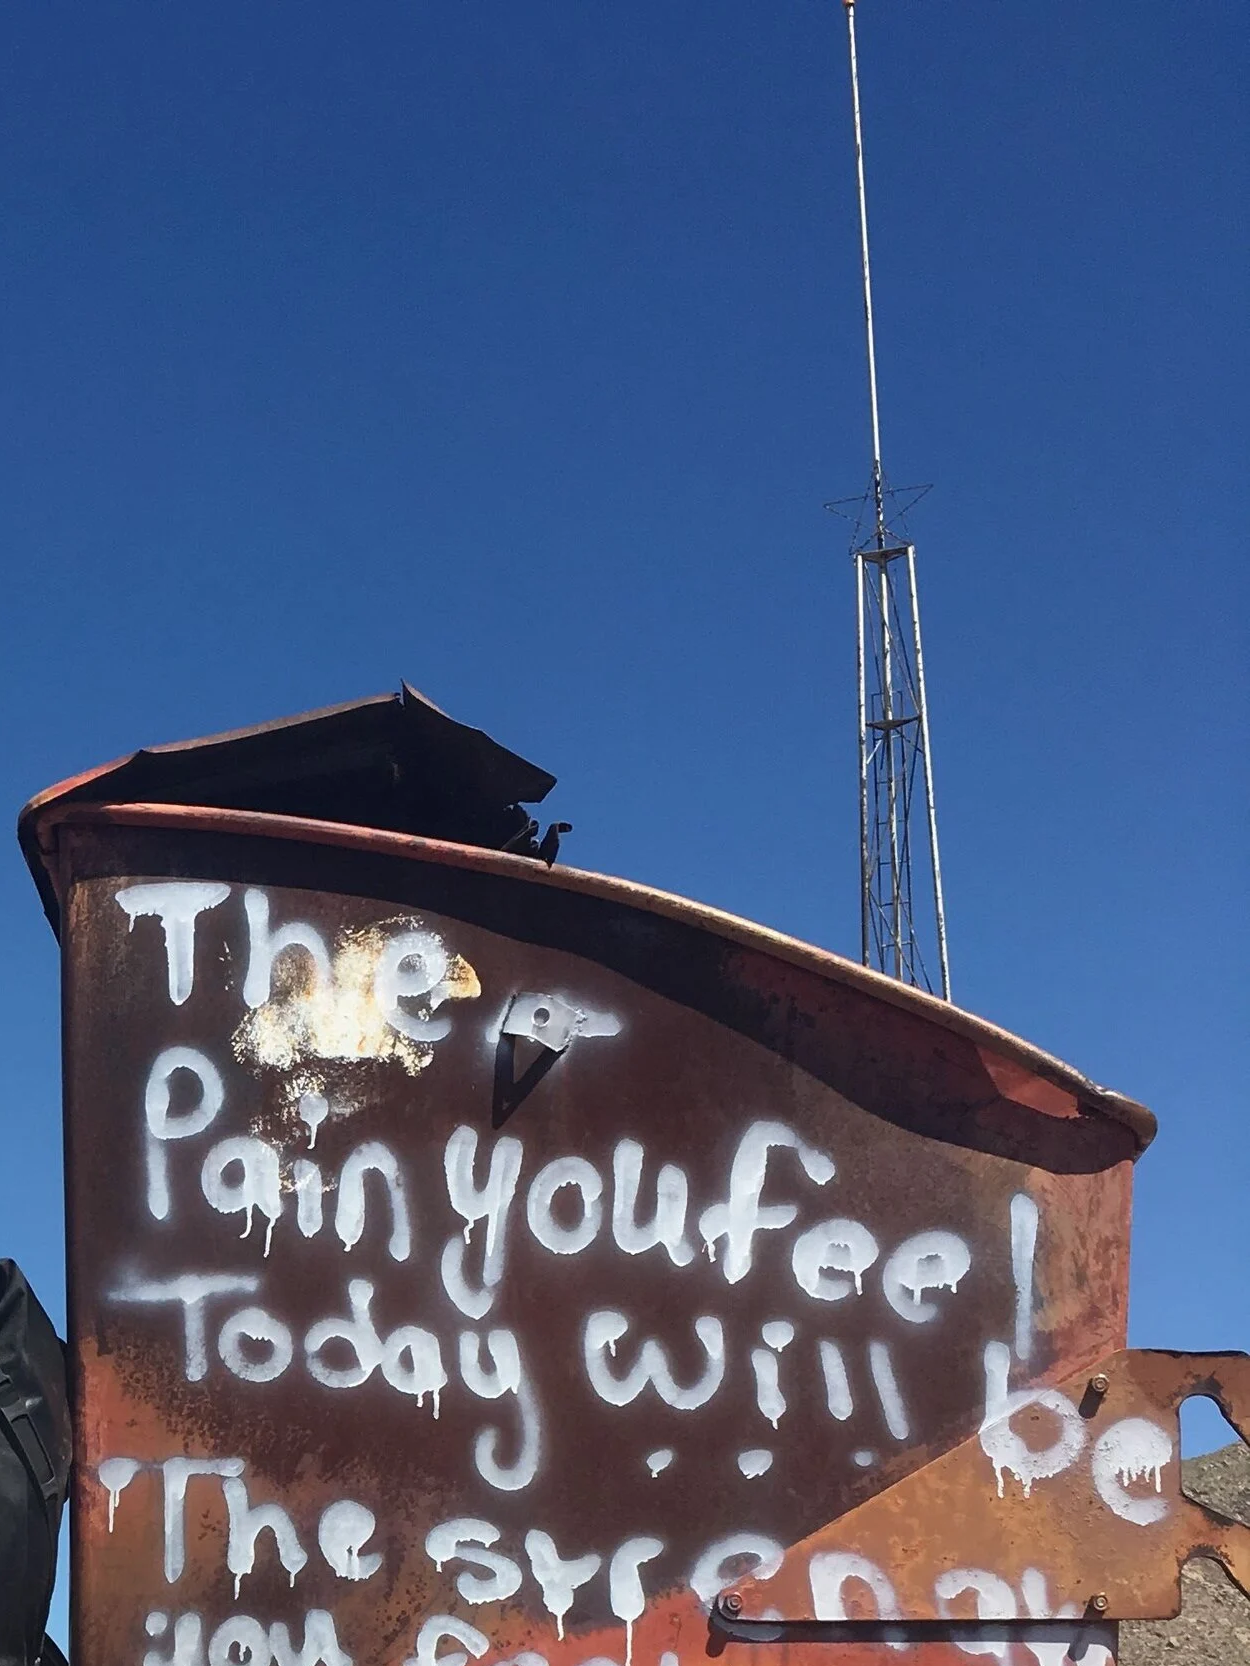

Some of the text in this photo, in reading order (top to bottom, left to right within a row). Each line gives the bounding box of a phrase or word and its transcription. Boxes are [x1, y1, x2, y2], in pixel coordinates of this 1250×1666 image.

[115, 882, 454, 1042] The
[145, 1046, 1040, 1362] Pain you feel
[108, 1278, 1174, 1526] Today will be
[98, 1457, 384, 1600] The
